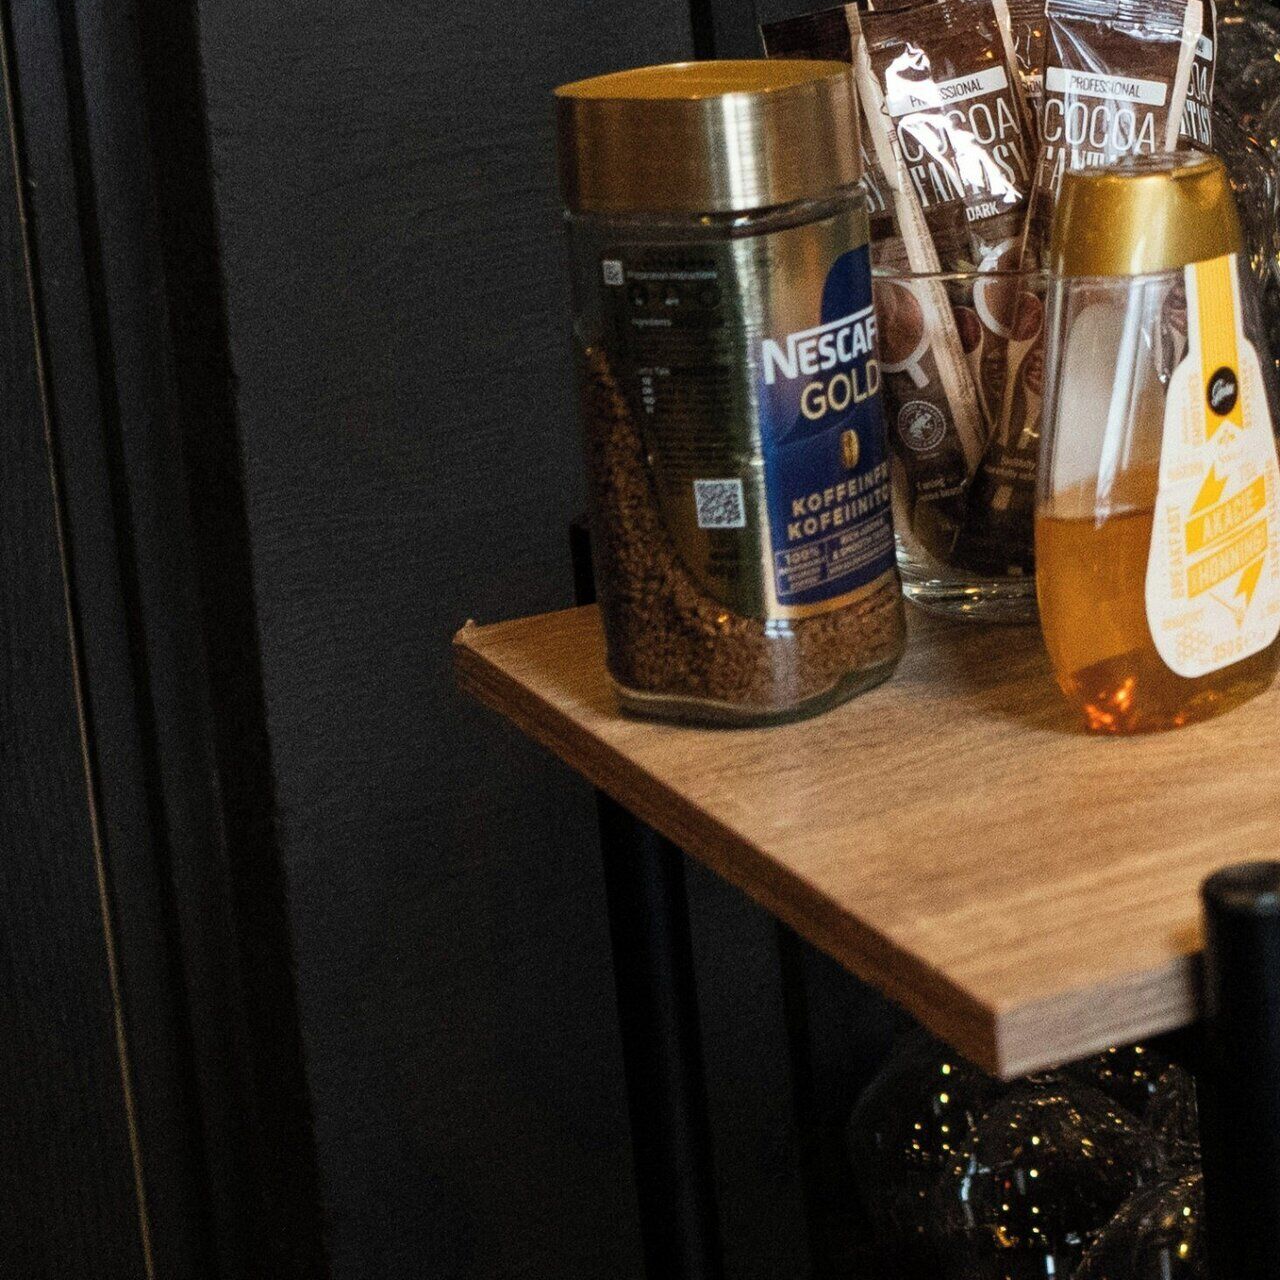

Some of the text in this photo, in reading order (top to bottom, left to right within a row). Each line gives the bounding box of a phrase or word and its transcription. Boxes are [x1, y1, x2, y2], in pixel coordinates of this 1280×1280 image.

[909, 78, 984, 108] PRSSIONAL
[1070, 75, 1141, 98] PROFESSIONAL
[1044, 99, 1156, 154] COCOA
[909, 141, 1030, 207] FANSY
[965, 202, 1000, 221] DARK
[762, 307, 877, 385] NESCAF
[801, 359, 880, 420] GOLD
